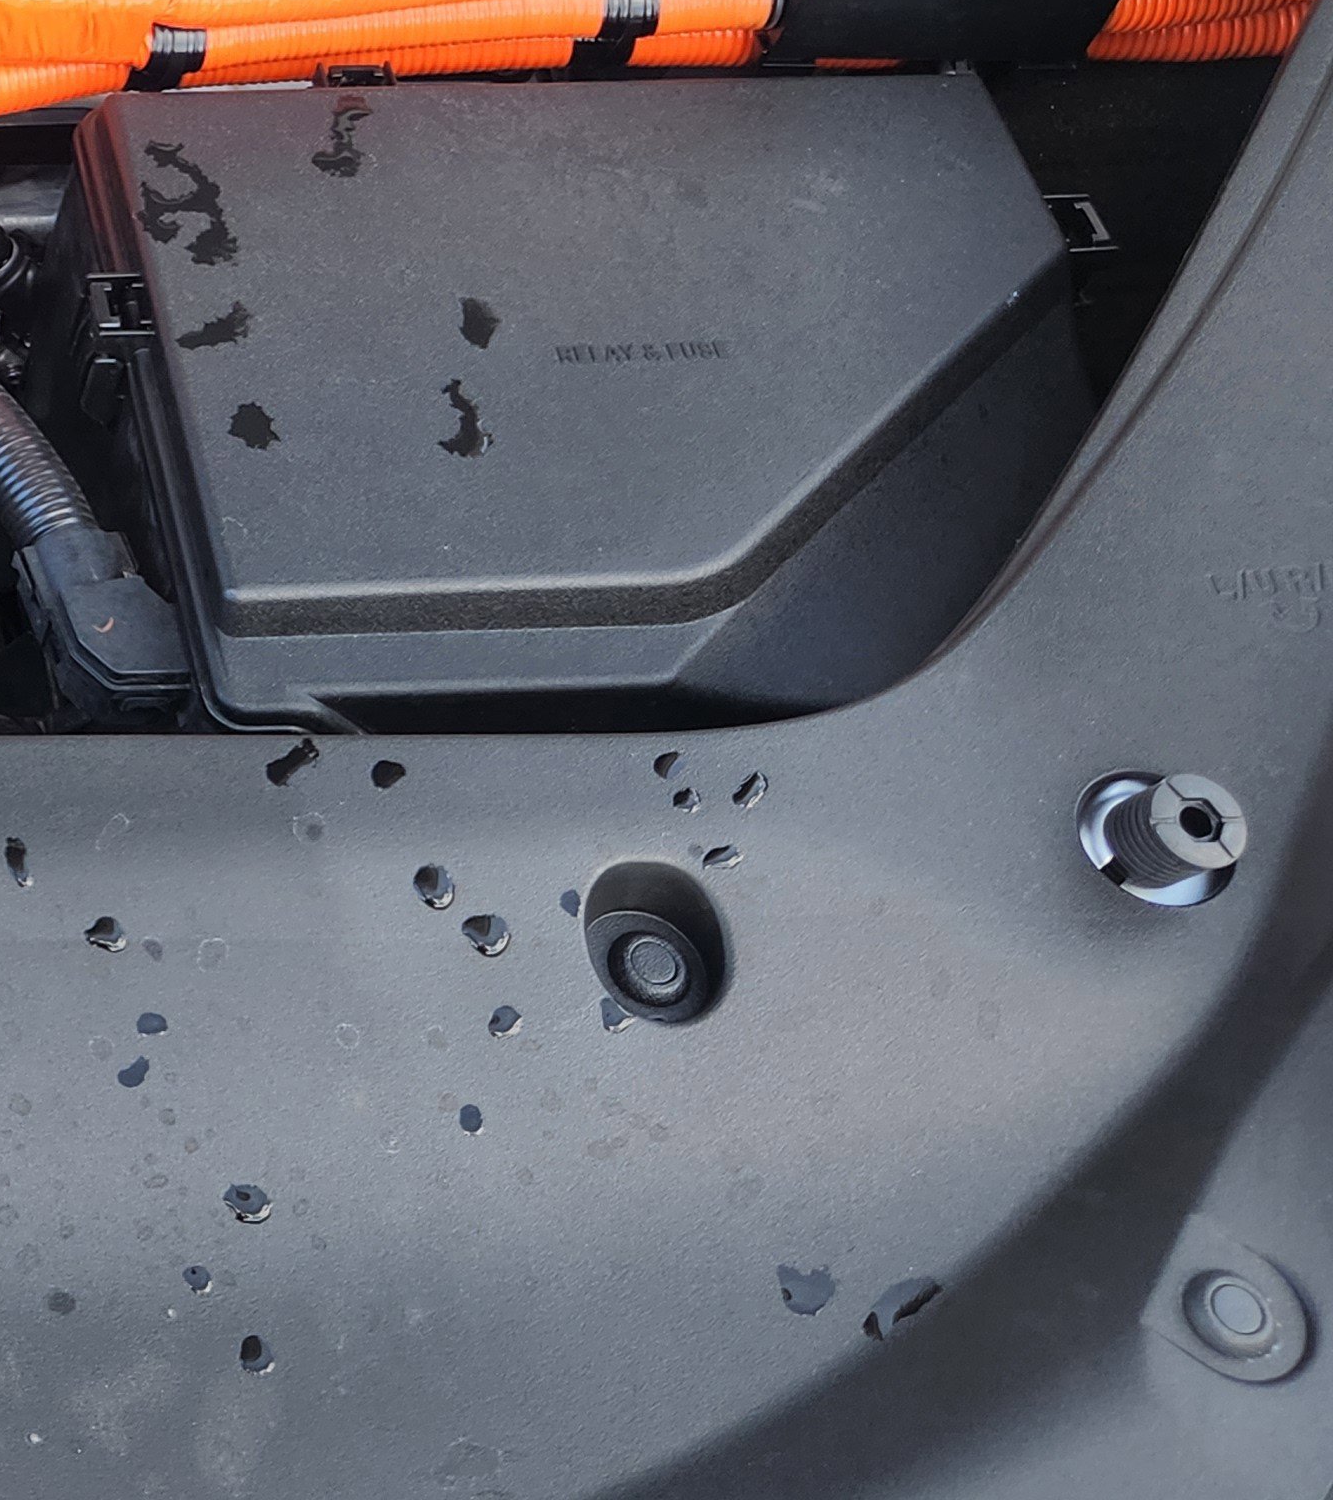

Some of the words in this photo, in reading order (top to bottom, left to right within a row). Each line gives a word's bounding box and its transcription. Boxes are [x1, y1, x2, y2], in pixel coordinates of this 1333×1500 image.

[555, 342, 633, 363] RELAY
[641, 343, 662, 362] &
[664, 340, 728, 362] FUSE
